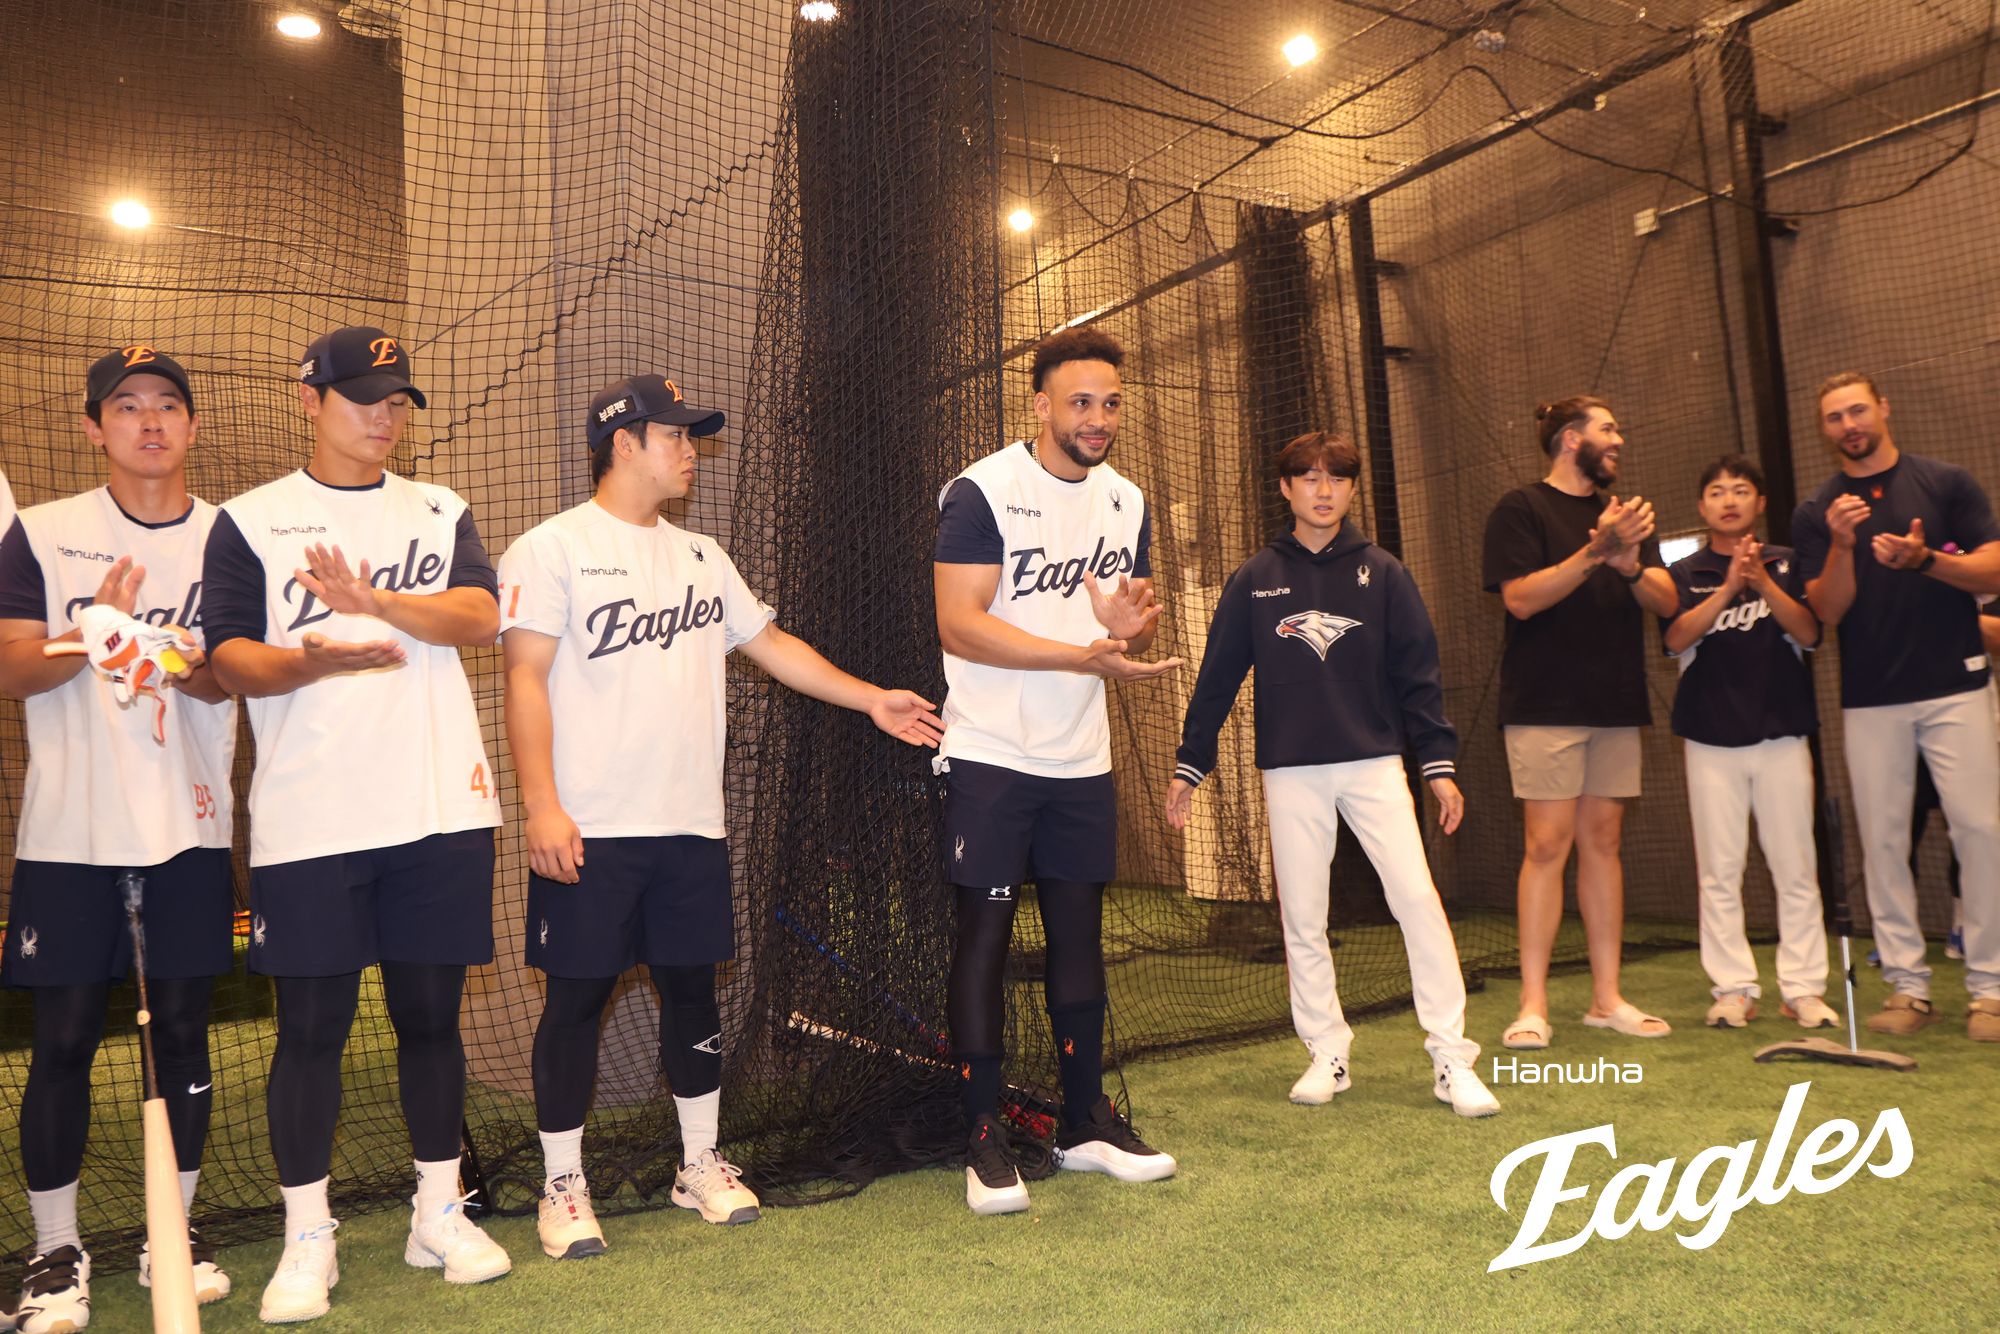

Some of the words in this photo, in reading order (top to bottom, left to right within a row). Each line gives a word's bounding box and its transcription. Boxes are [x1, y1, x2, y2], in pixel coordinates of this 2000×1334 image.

[121, 344, 157, 368] E
[368, 337, 398, 368] E
[598, 398, 627, 423] 부루펜
[270, 525, 327, 536] Hanwha
[57, 544, 115, 563] Hanwha
[581, 567, 628, 577] Hanwha
[1010, 536, 1133, 601] Eagles
[498, 583, 521, 618] 1
[1251, 587, 1291, 599] Hanwha
[586, 584, 724, 660] Eagles
[470, 762, 497, 799] 4
[193, 784, 216, 820] 95
